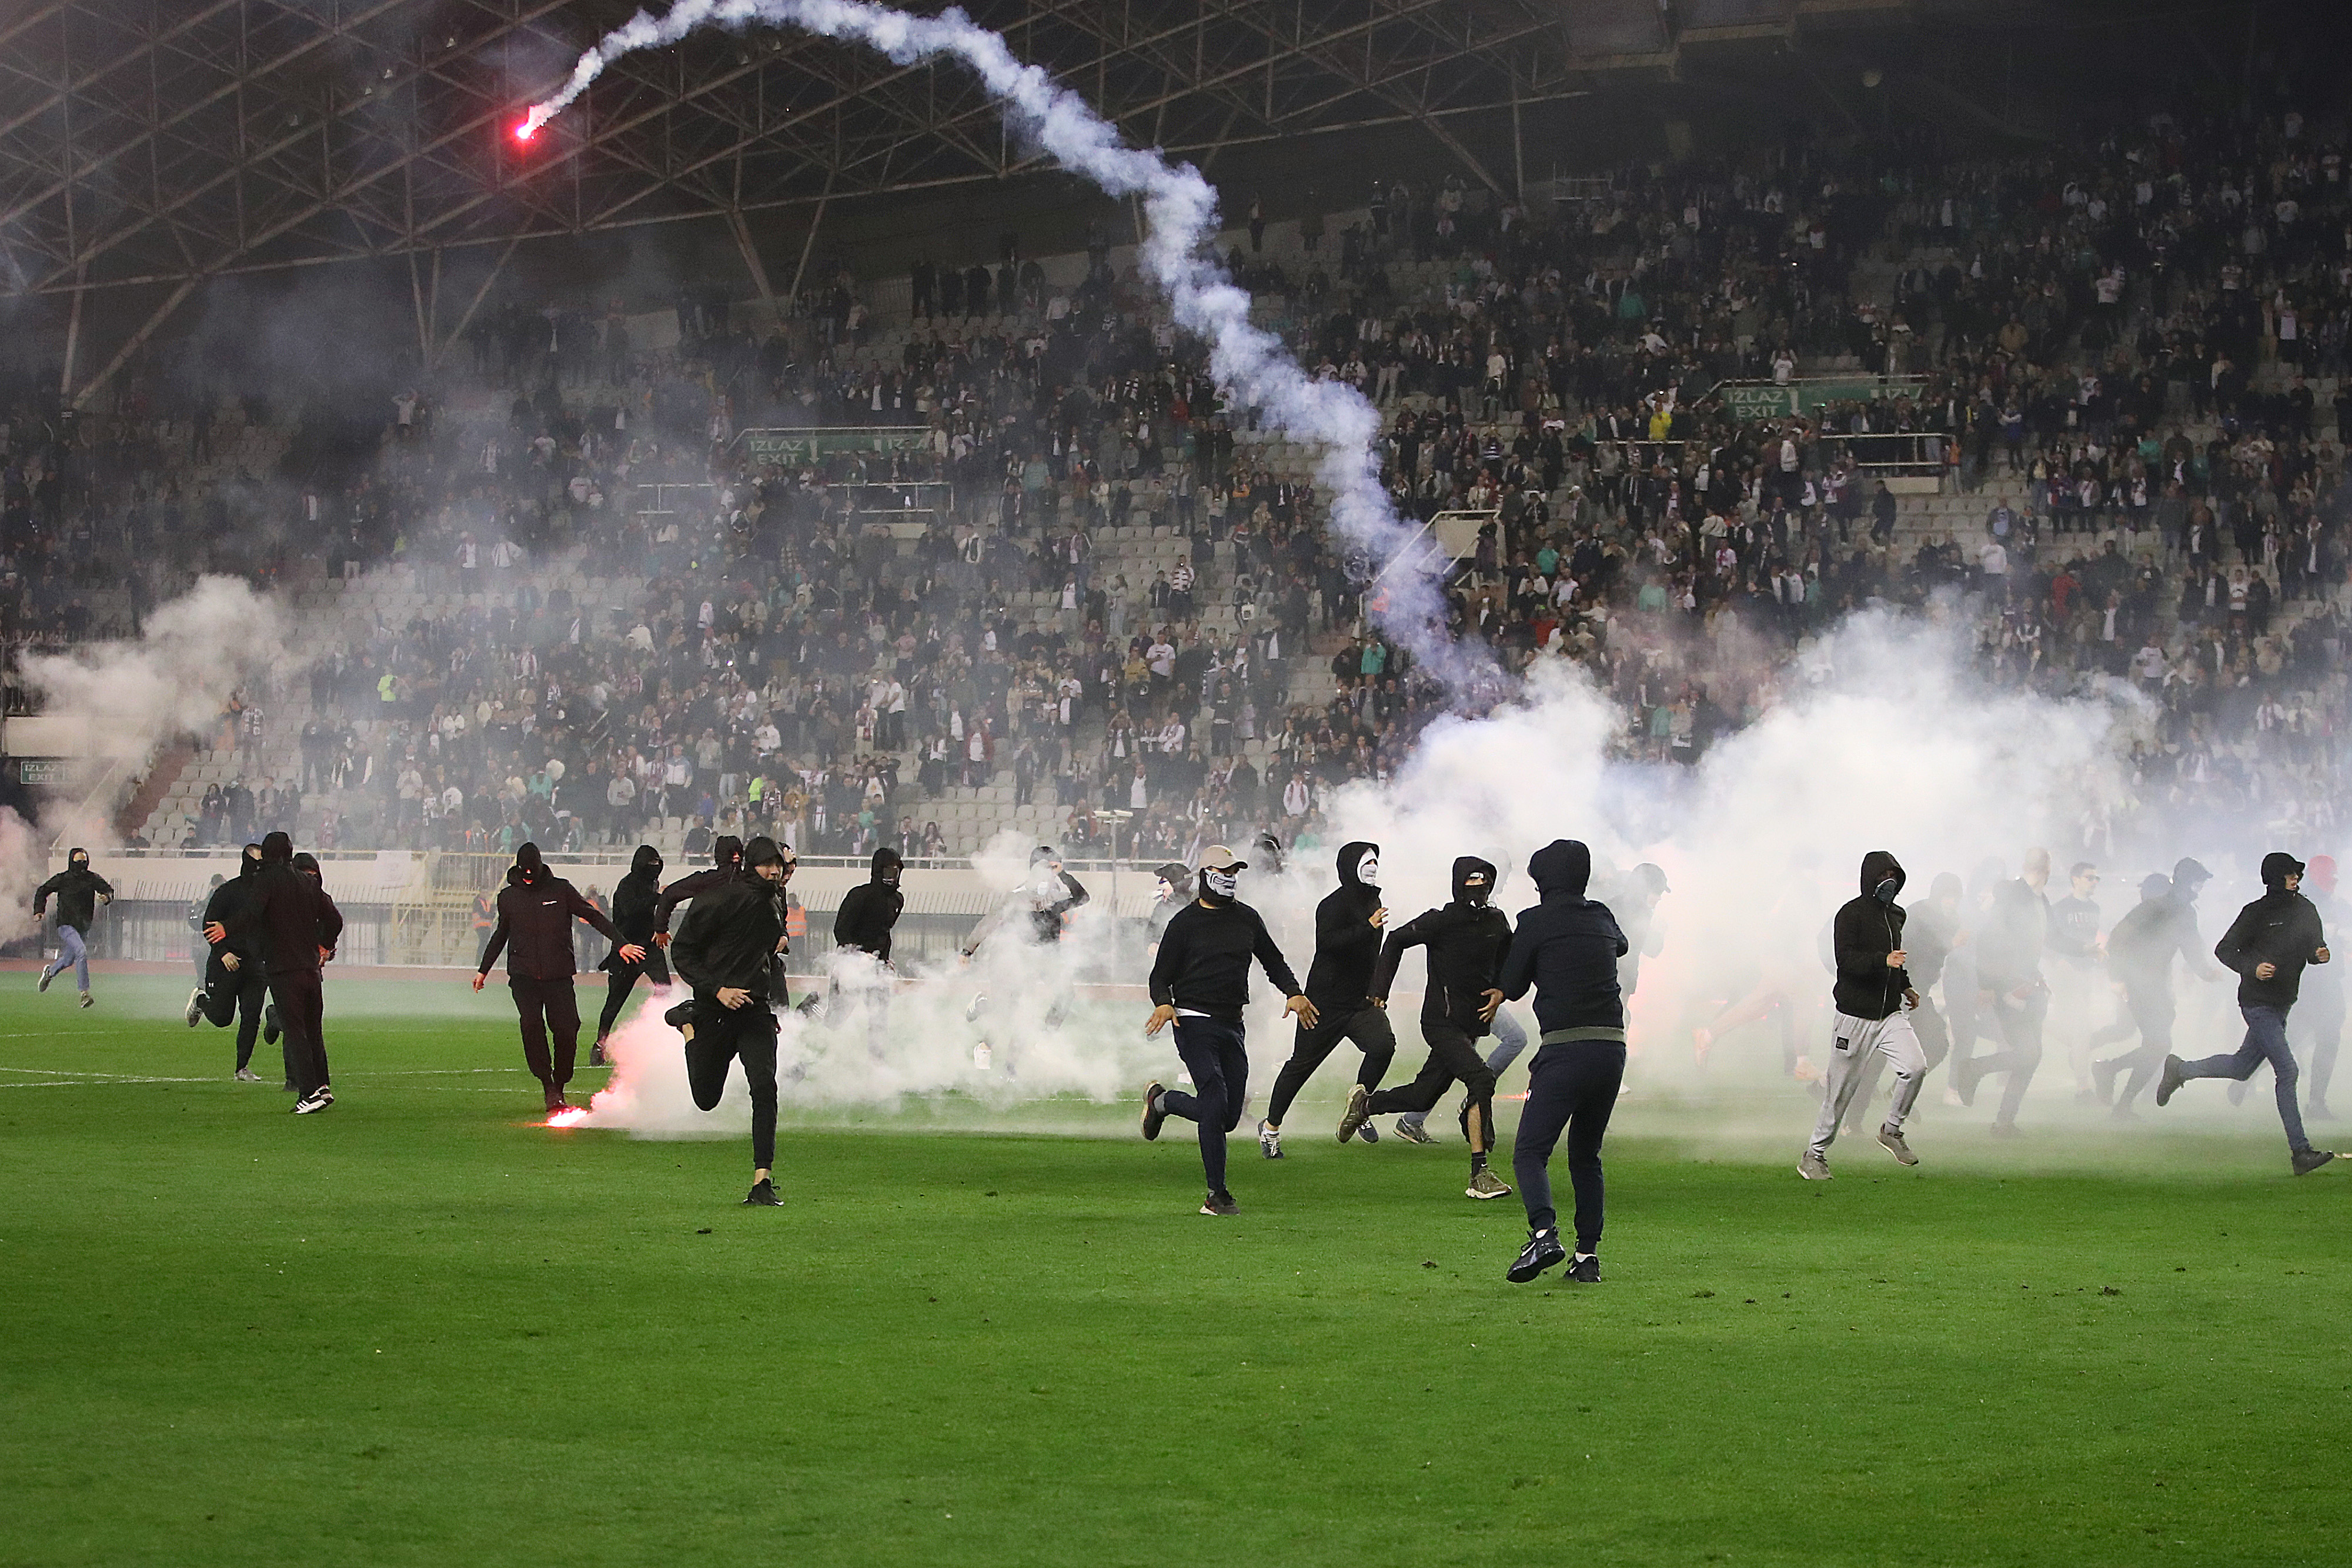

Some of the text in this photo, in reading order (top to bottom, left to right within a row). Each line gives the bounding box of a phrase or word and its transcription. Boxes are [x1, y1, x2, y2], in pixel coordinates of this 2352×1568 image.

[1729, 390, 1783, 403] IZLAZ
[1736, 406, 1778, 417] EXIT
[750, 440, 803, 451] IZLAZ
[757, 453, 798, 465] EXIT
